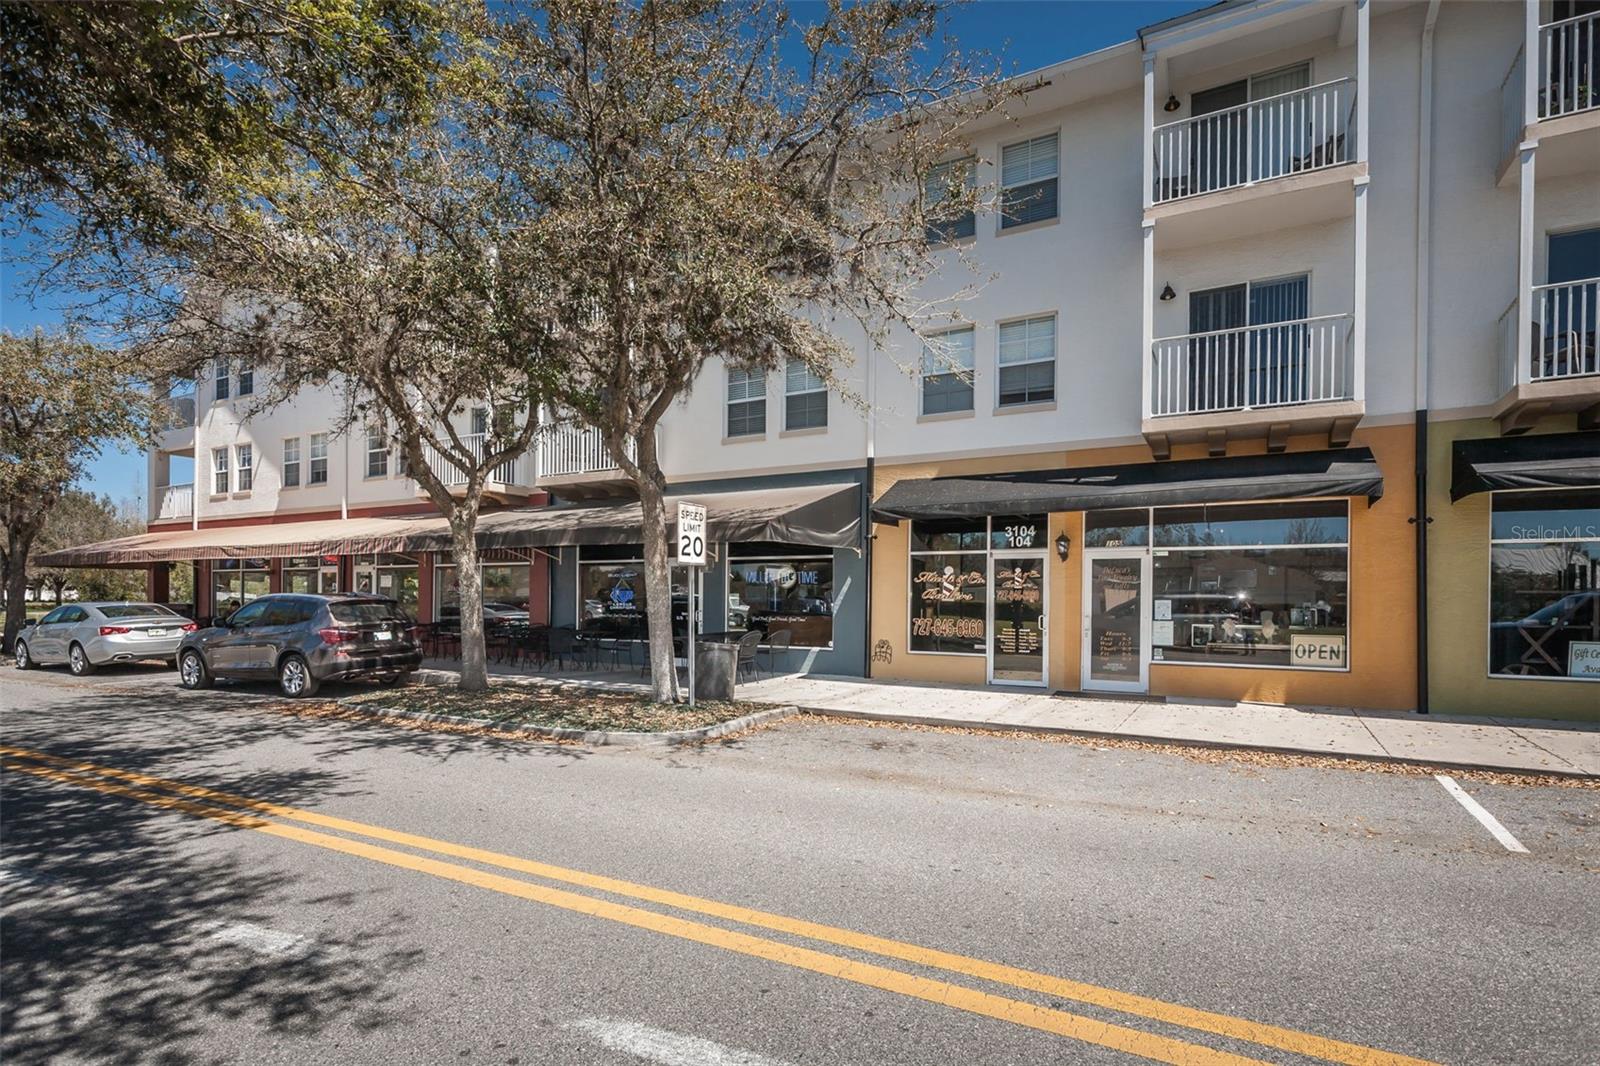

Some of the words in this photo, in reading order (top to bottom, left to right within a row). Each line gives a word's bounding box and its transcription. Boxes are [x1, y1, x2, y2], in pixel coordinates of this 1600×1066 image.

[681, 510, 704, 522] SPEED
[683, 523, 702, 533] LIMIT
[1005, 525, 1036, 537] 3104
[681, 535, 703, 557] 20
[1009, 535, 1032, 547] 104
[797, 571, 818, 584] TIME
[912, 617, 984, 638] 727-645-6960
[1295, 643, 1340, 661] OPEN
[1574, 647, 1589, 661] Gift
